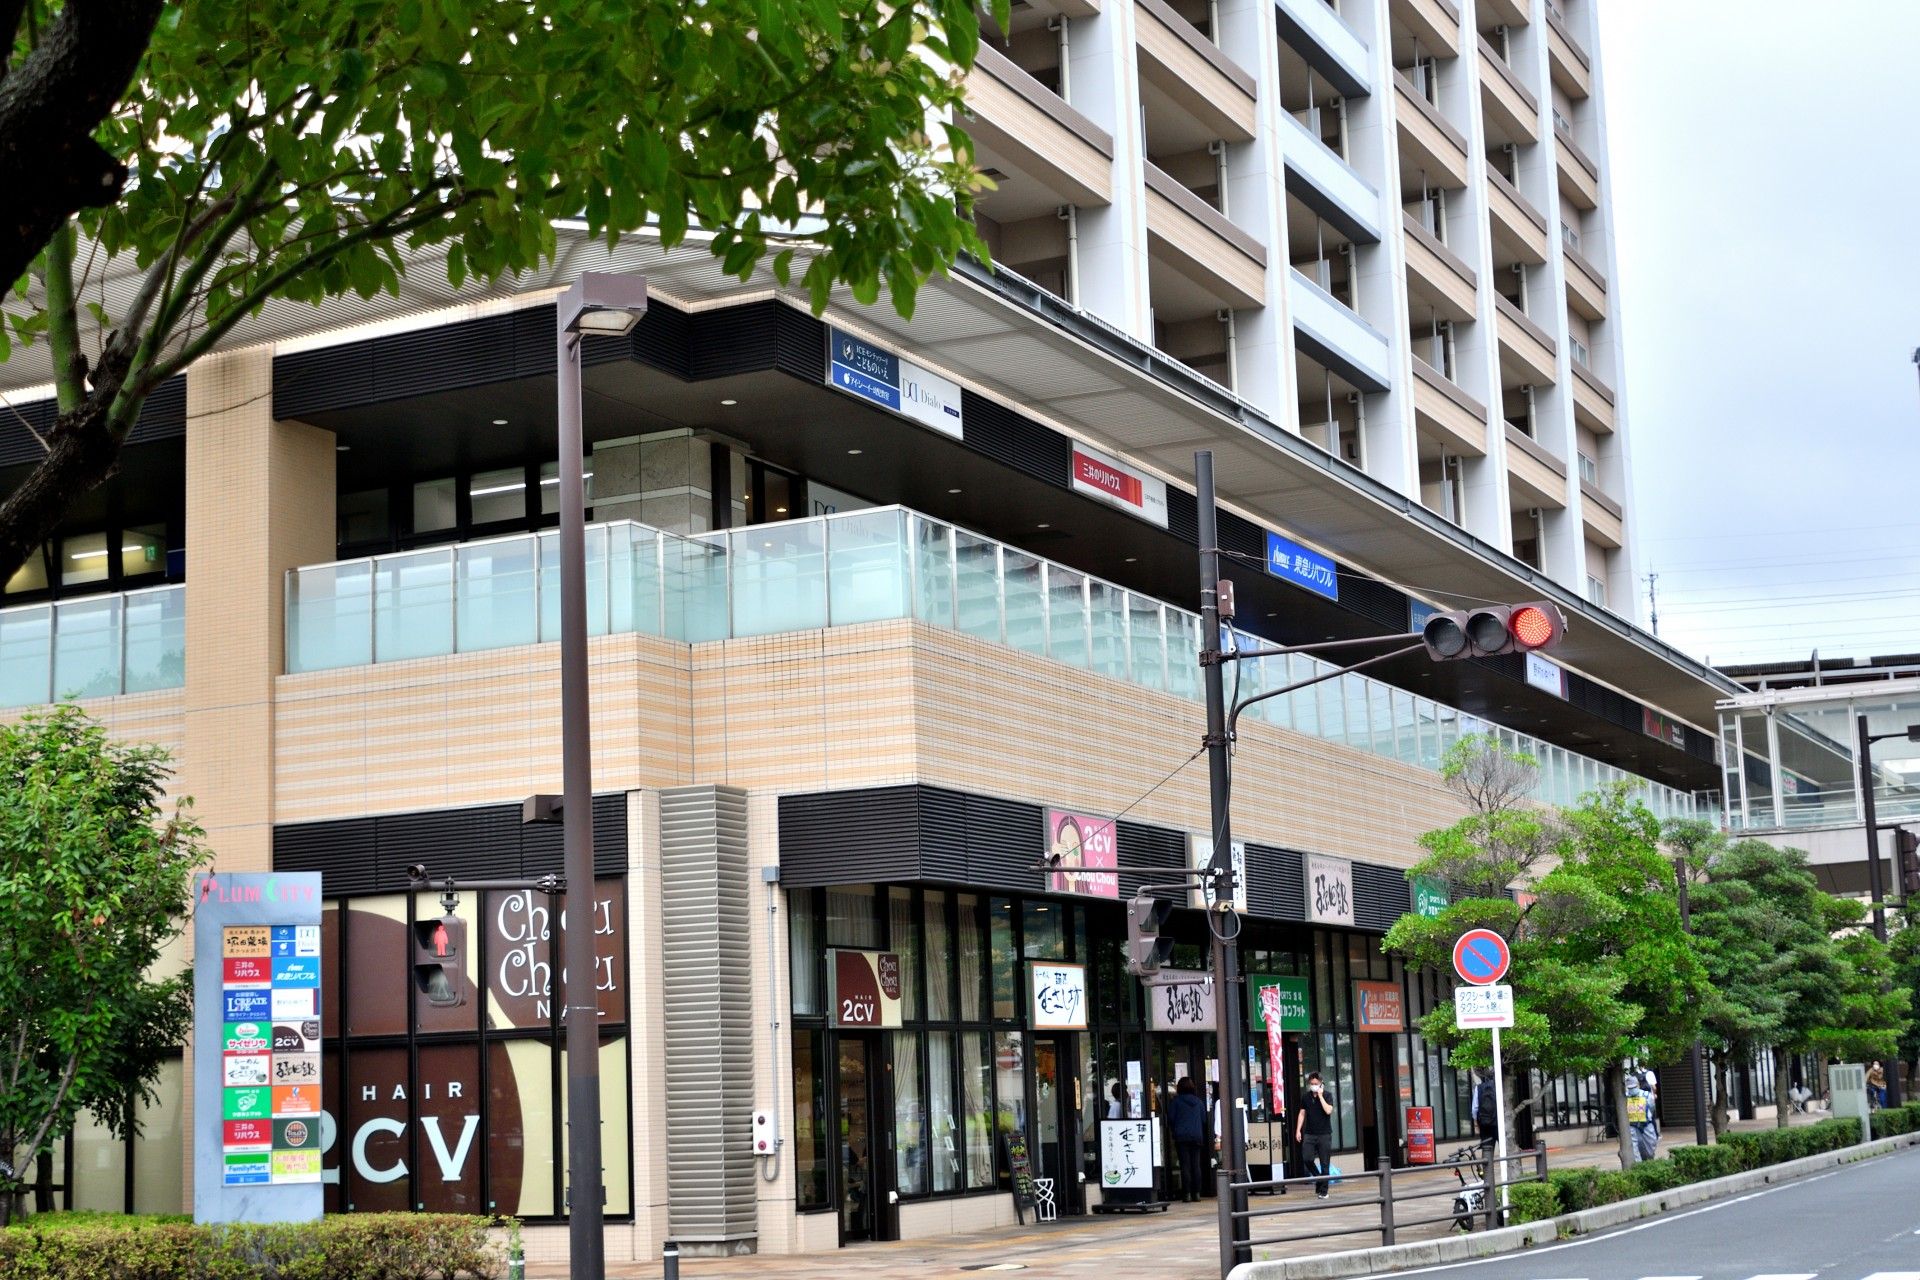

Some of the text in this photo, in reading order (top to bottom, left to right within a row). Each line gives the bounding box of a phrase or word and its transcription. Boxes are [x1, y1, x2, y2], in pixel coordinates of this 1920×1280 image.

[1082, 461, 1121, 492] 三井のリハウス
[1293, 554, 1333, 588] 東急リバブル
[1084, 825, 1112, 854] 2CV
[234, 961, 254, 969] 三井の
[234, 969, 260, 977] リハウス
[234, 997, 268, 1005] CREATE
[842, 999, 874, 1022] 2CV
[228, 1038, 268, 1049] サイゼリヤ
[274, 1038, 300, 1047] 2CV
[362, 1081, 463, 1101] HAIR
[234, 1123, 254, 1131] 三井の
[234, 1131, 260, 1140] リハウス
[228, 1164, 267, 1172] FamilyMart
